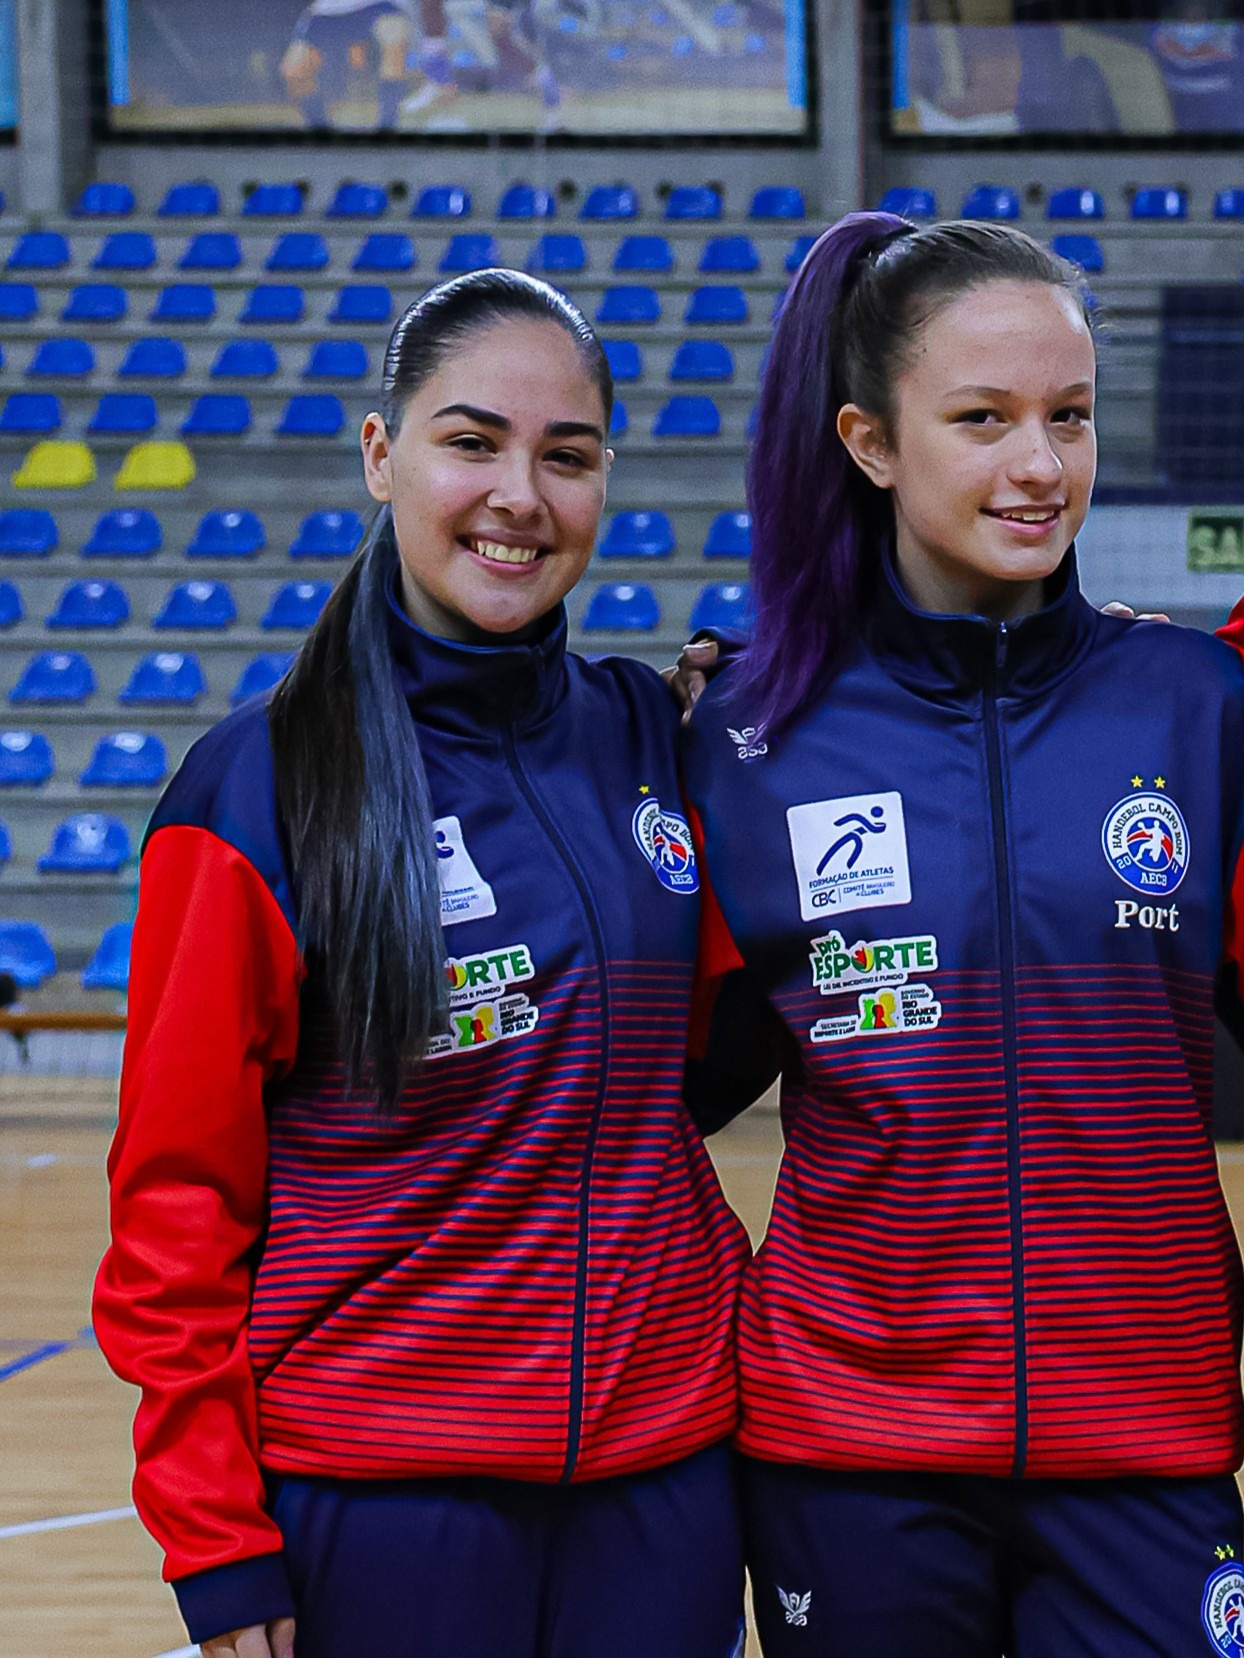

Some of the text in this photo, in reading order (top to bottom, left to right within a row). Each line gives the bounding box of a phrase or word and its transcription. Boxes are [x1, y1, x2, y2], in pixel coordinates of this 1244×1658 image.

[1112, 802, 1147, 850] HANDEBOL
[1148, 802, 1179, 830] CAMPO
[849, 871, 859, 880] DE
[860, 866, 894, 878] ATLETAS
[1116, 855, 1132, 870] 20
[811, 889, 837, 908] CBC
[1114, 899, 1180, 932] Port
[816, 935, 841, 957] pró
[446, 949, 531, 991] ORTE
[813, 940, 934, 982] ESPORTE
[904, 1017, 917, 1027] DO
